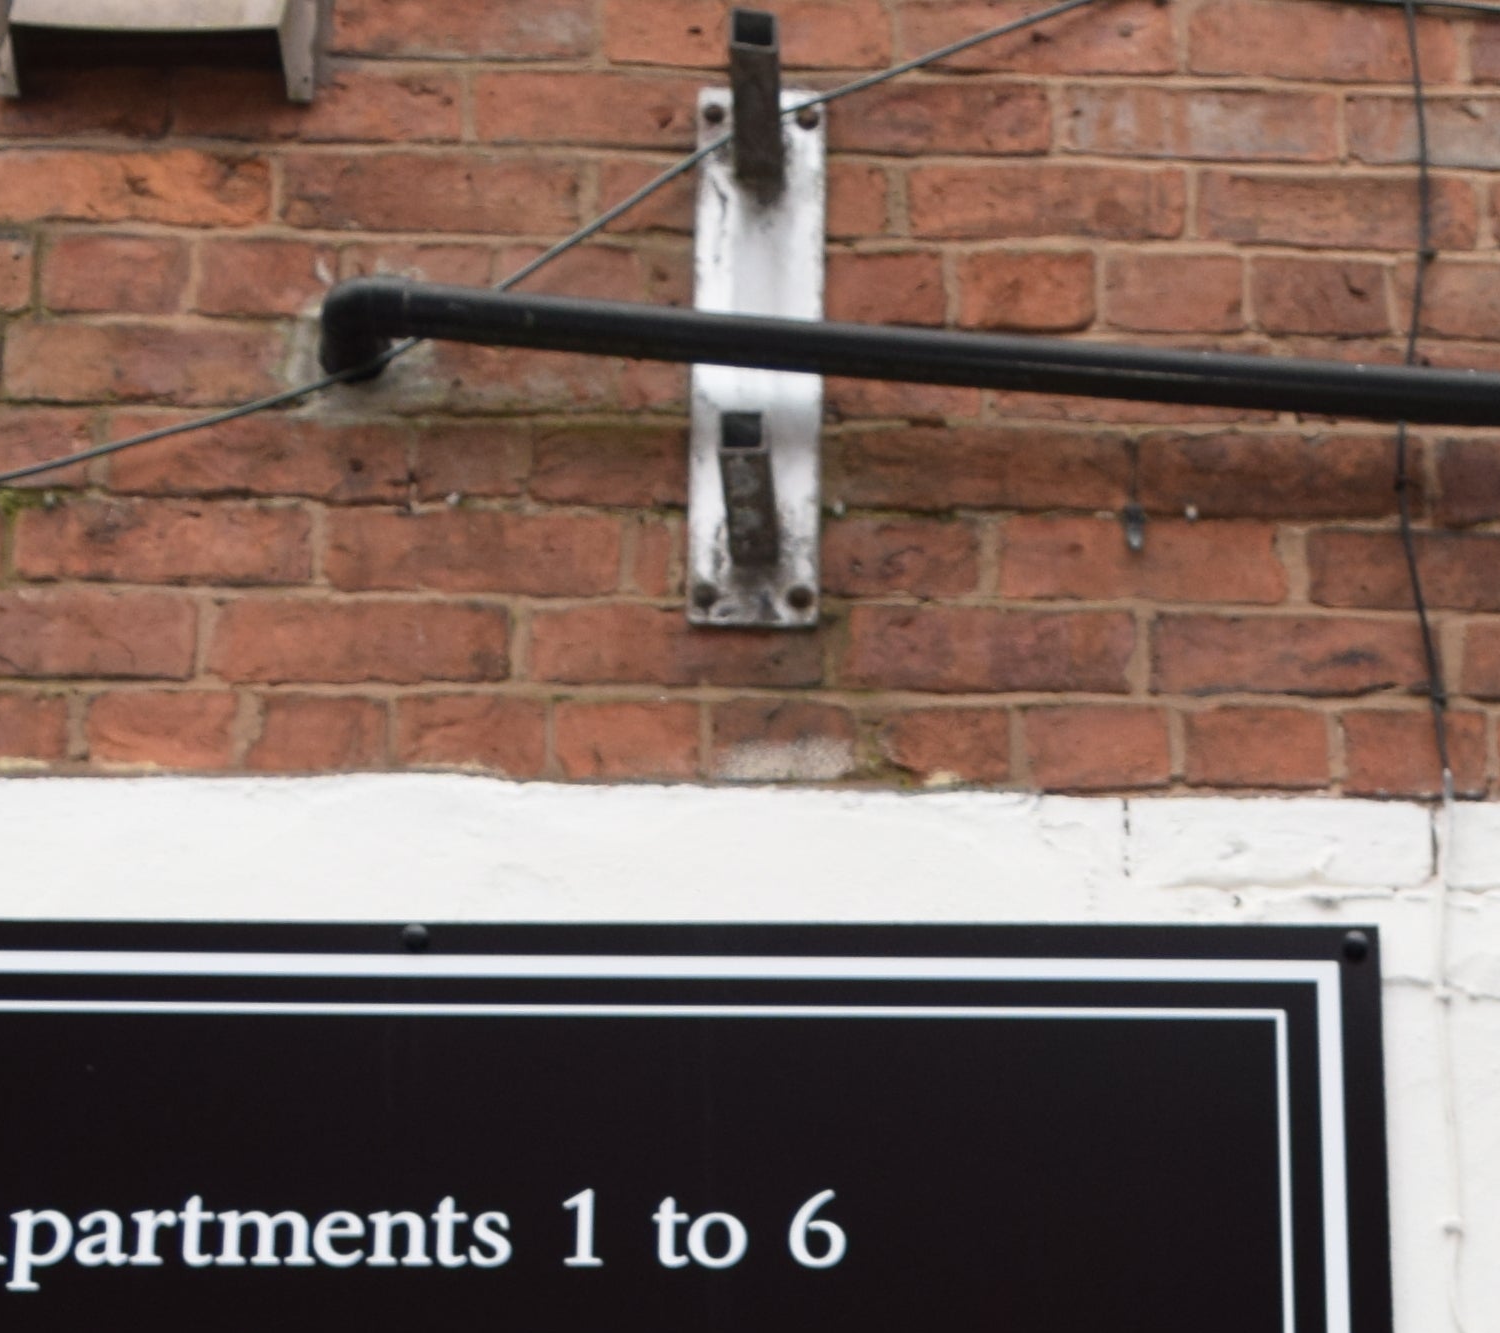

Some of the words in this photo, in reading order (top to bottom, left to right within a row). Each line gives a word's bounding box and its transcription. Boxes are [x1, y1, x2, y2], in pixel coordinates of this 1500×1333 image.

[561, 1187, 604, 1268] 1
[651, 1195, 749, 1270] to
[787, 1188, 848, 1269] 6
